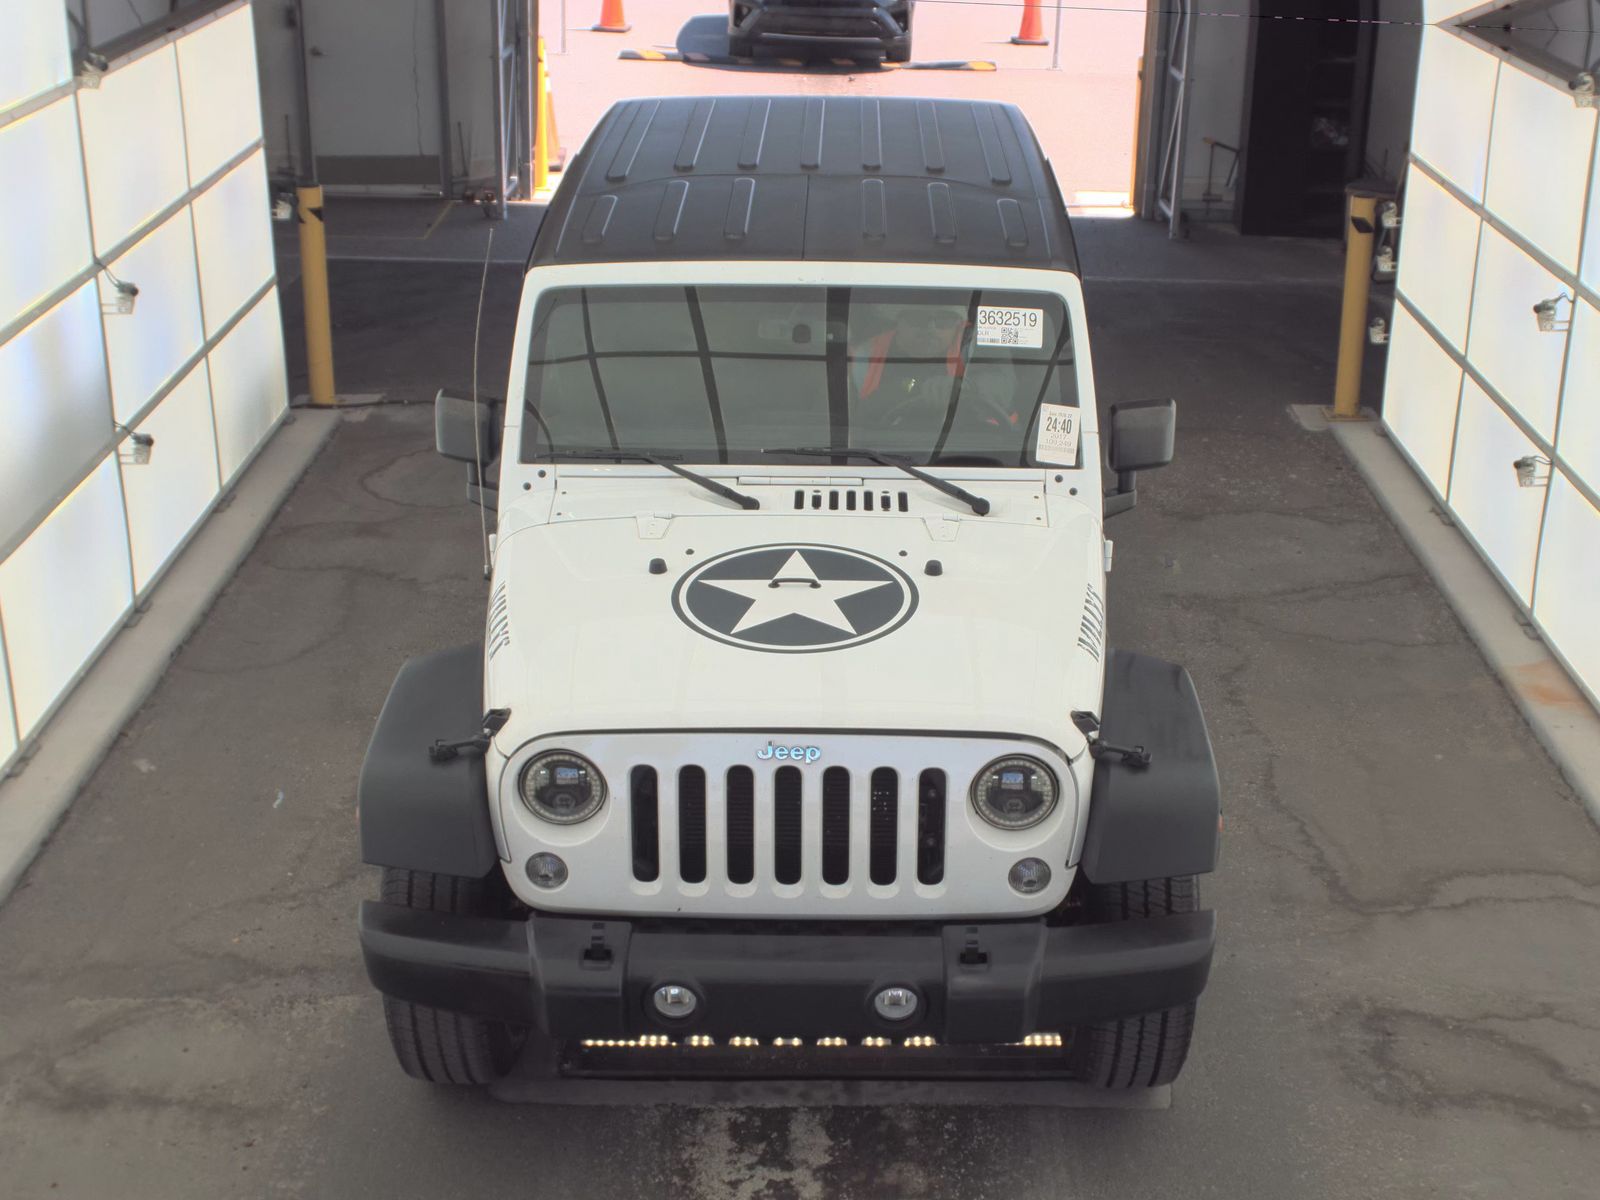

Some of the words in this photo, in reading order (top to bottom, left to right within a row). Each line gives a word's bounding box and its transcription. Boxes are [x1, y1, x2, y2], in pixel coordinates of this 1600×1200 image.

[979, 309, 1038, 328] 3632519
[1046, 416, 1072, 434] 24:40
[757, 740, 821, 764] Jeep
